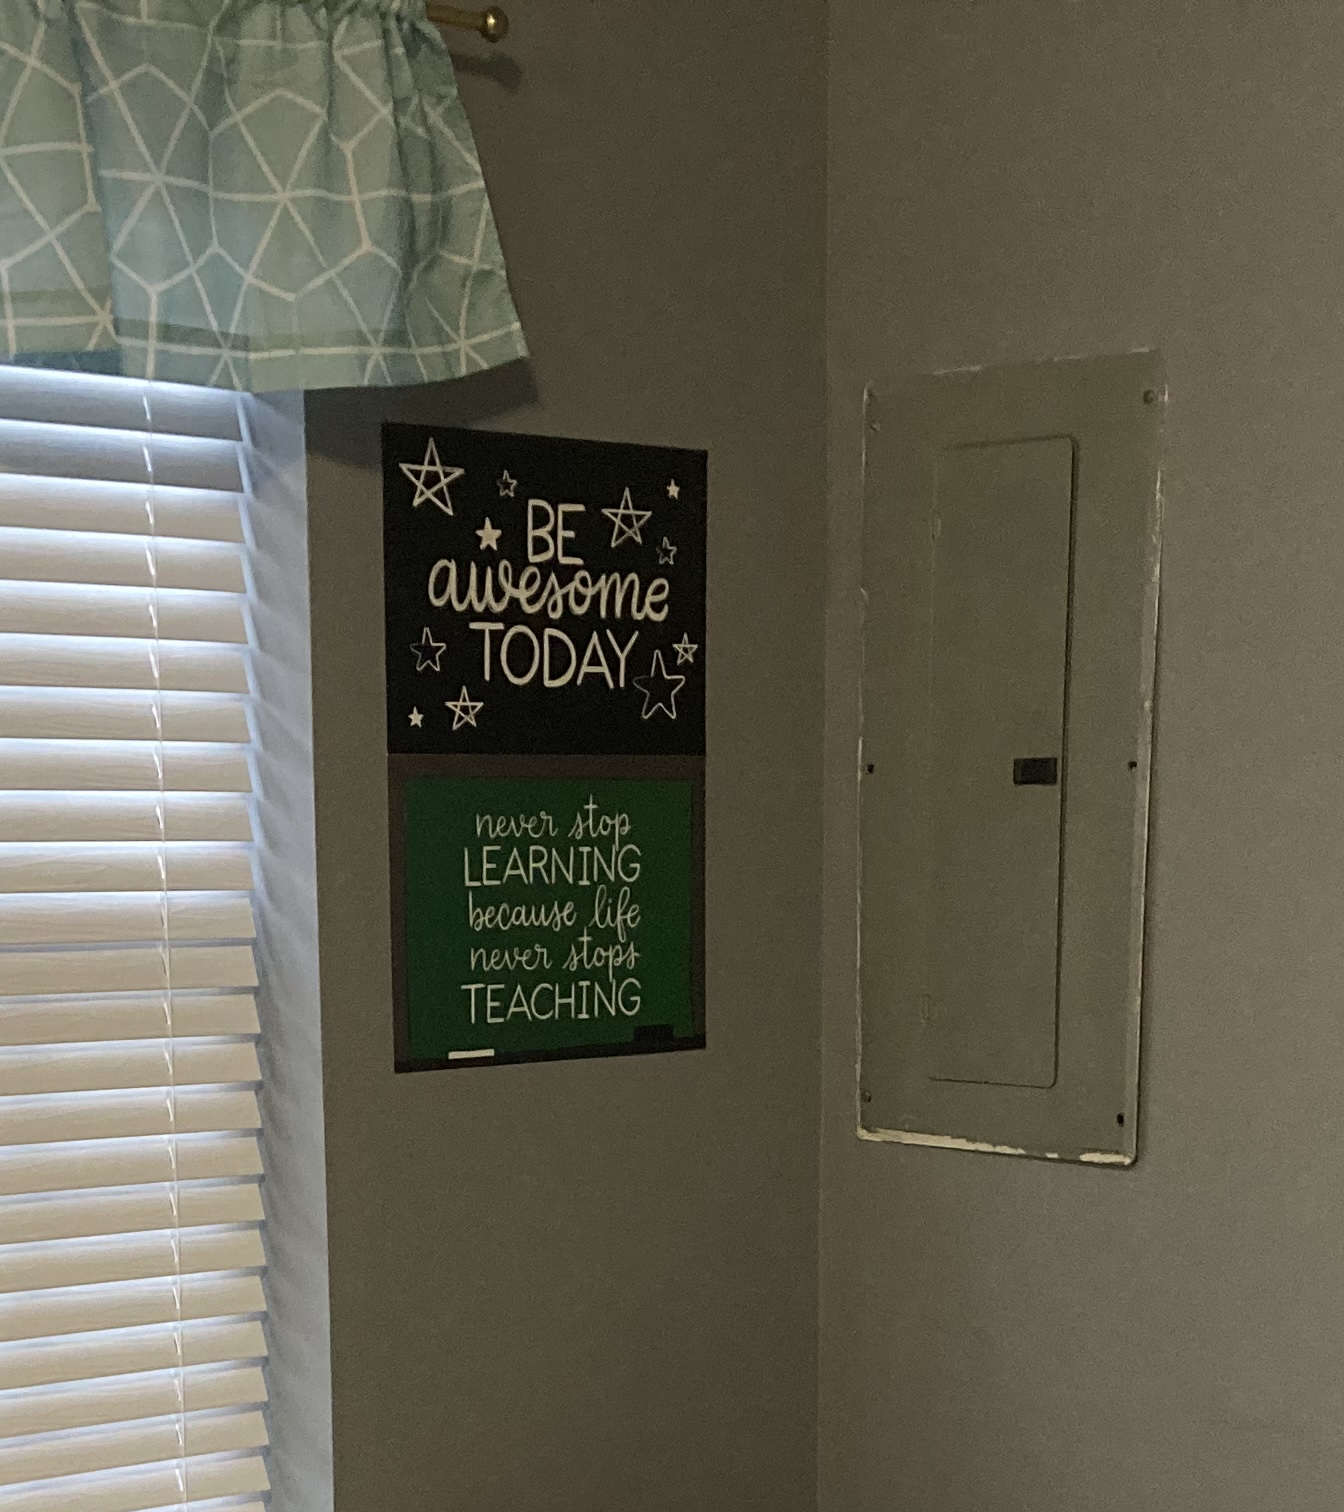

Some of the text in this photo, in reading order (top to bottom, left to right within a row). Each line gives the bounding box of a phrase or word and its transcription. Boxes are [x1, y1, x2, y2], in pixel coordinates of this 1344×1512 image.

[527, 499, 586, 565] BE
[428, 559, 669, 622] awesome
[469, 621, 639, 689] TODAY
[476, 794, 631, 851] never stop
[463, 844, 642, 887] LEARNING
[468, 884, 641, 942] because life
[470, 926, 640, 982] never stops
[461, 977, 642, 1024] TEACHING
